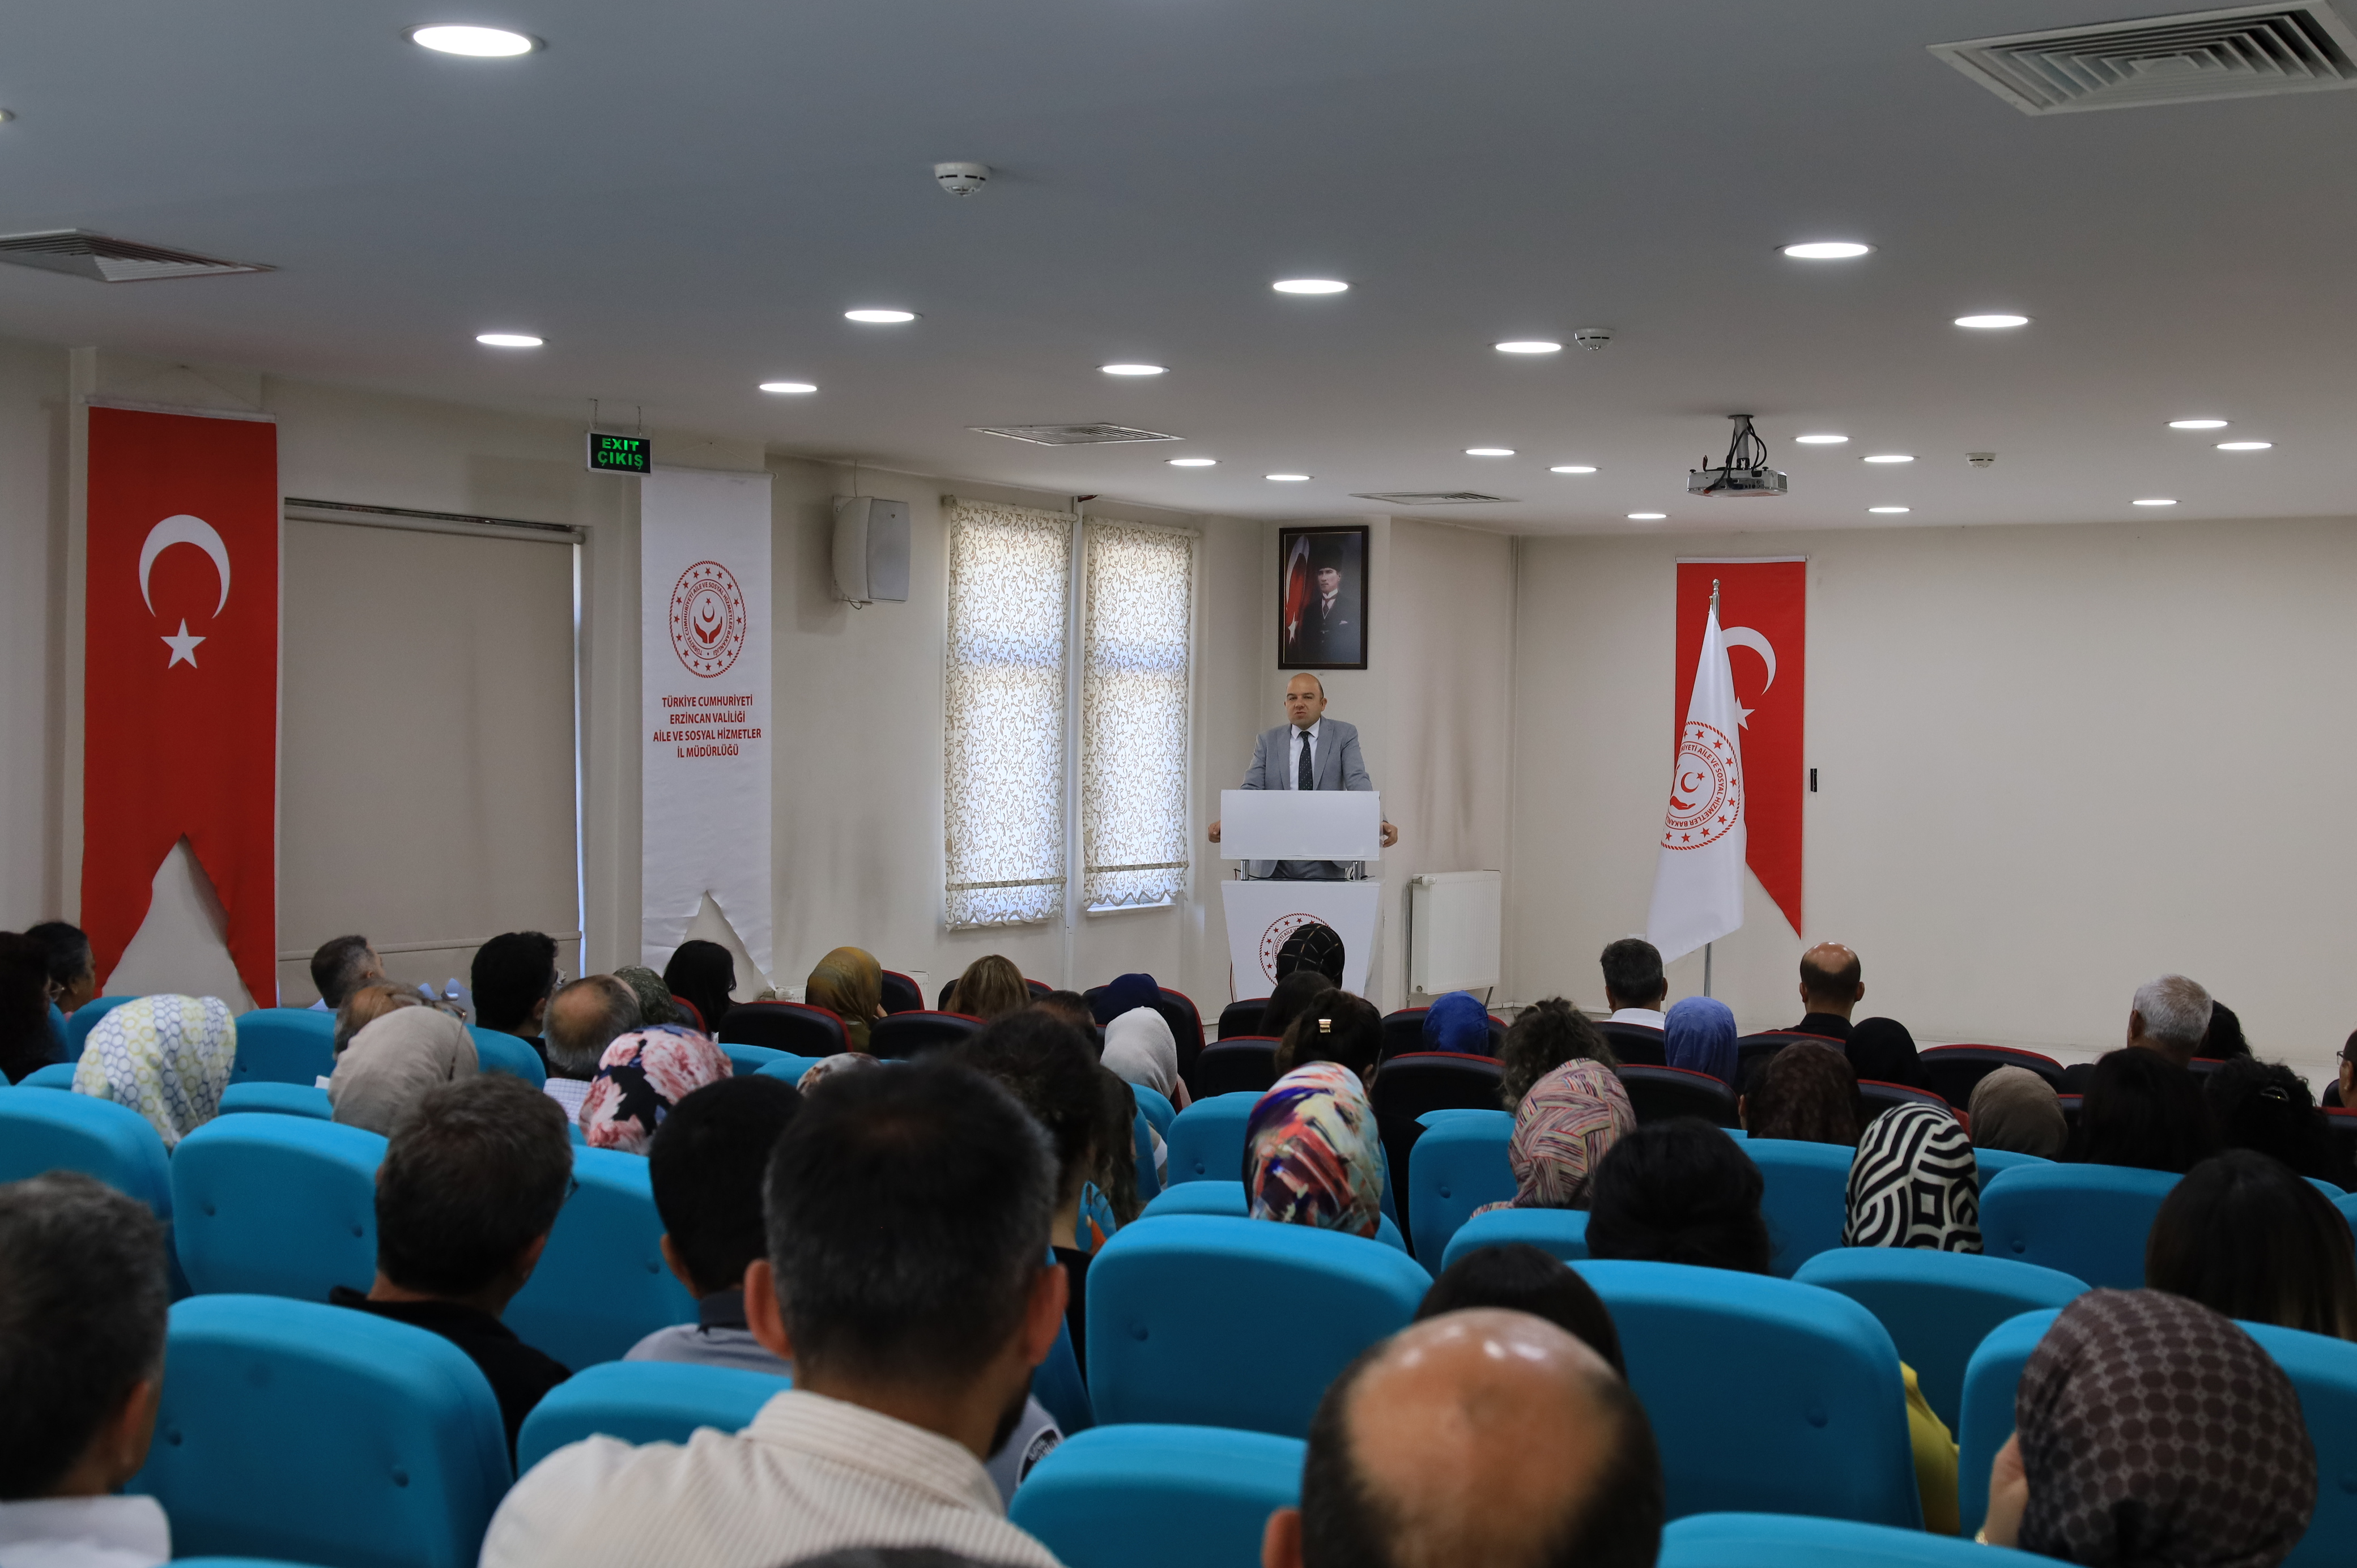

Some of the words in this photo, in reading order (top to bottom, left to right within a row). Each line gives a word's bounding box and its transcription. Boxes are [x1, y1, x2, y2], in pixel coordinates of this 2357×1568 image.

[602, 437, 639, 451] EXIT
[597, 451, 644, 470] ÇIKIŞ
[693, 583, 703, 594] AİLE
[708, 582, 724, 595] SOSYAL
[683, 591, 695, 636] CUMHURİYETİ
[722, 594, 733, 630] HİZMETLER
[687, 636, 703, 656] TÜRKİYE
[662, 694, 696, 708] TÜRKİYE
[698, 694, 753, 706] CUMHURİYETİ
[670, 711, 711, 725] ERZİNCAN
[713, 710, 746, 723] VALİLİĞİ
[653, 730, 671, 742] AİLE
[673, 731, 683, 741] VE
[685, 730, 716, 741] SOSYAL
[717, 727, 761, 739] HİZMETLER
[677, 745, 684, 758] İL
[686, 744, 739, 757] MÜDÜRLÜĞÜ
[1697, 748, 1713, 760] AİLE
[1711, 757, 1719, 768] VE
[1715, 768, 1724, 795] SOSYAL
[1689, 796, 1721, 826] HİZMETLER
